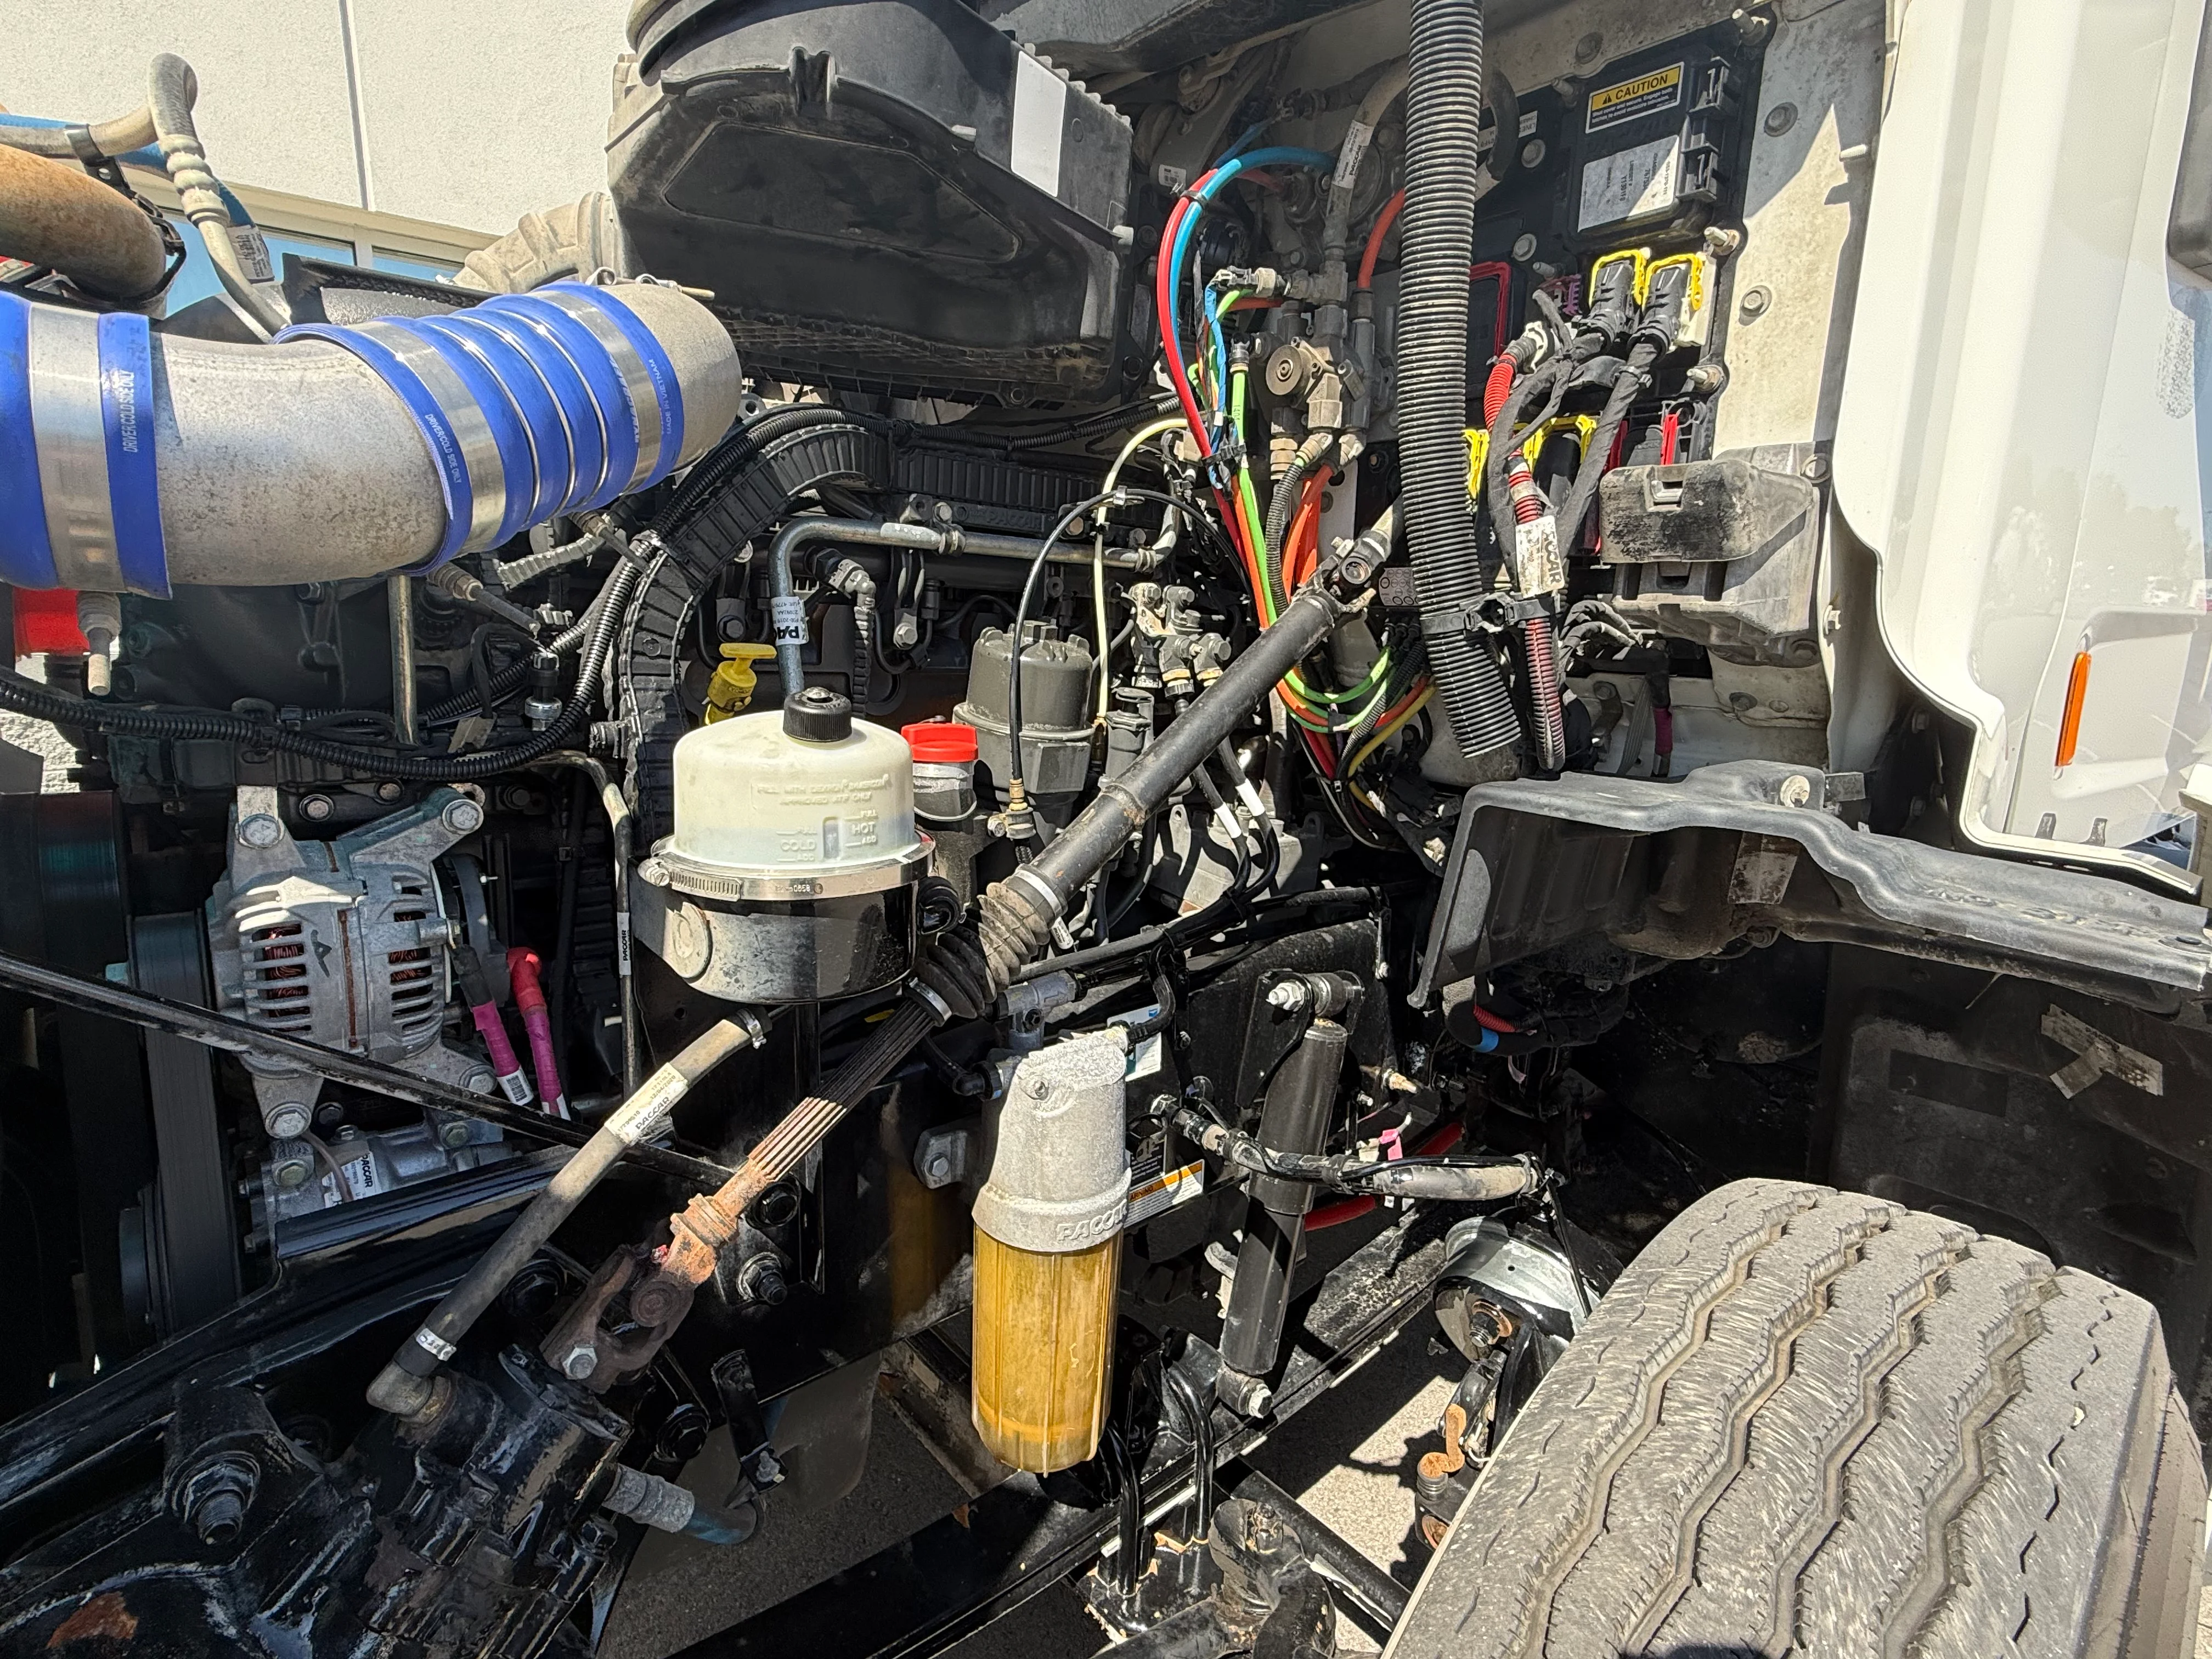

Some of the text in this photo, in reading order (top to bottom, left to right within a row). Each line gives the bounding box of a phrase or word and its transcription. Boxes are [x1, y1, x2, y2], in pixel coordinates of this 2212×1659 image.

[1615, 74, 1668, 100] CAUTION
[648, 359, 668, 399] VIETNAM
[663, 400, 670, 409] IN
[425, 414, 461, 483] DRIVER/COLD SIDE ONLY
[851, 823, 876, 835] HOT
[780, 839, 816, 851] COLD
[635, 1096, 670, 1130] PACCAR
